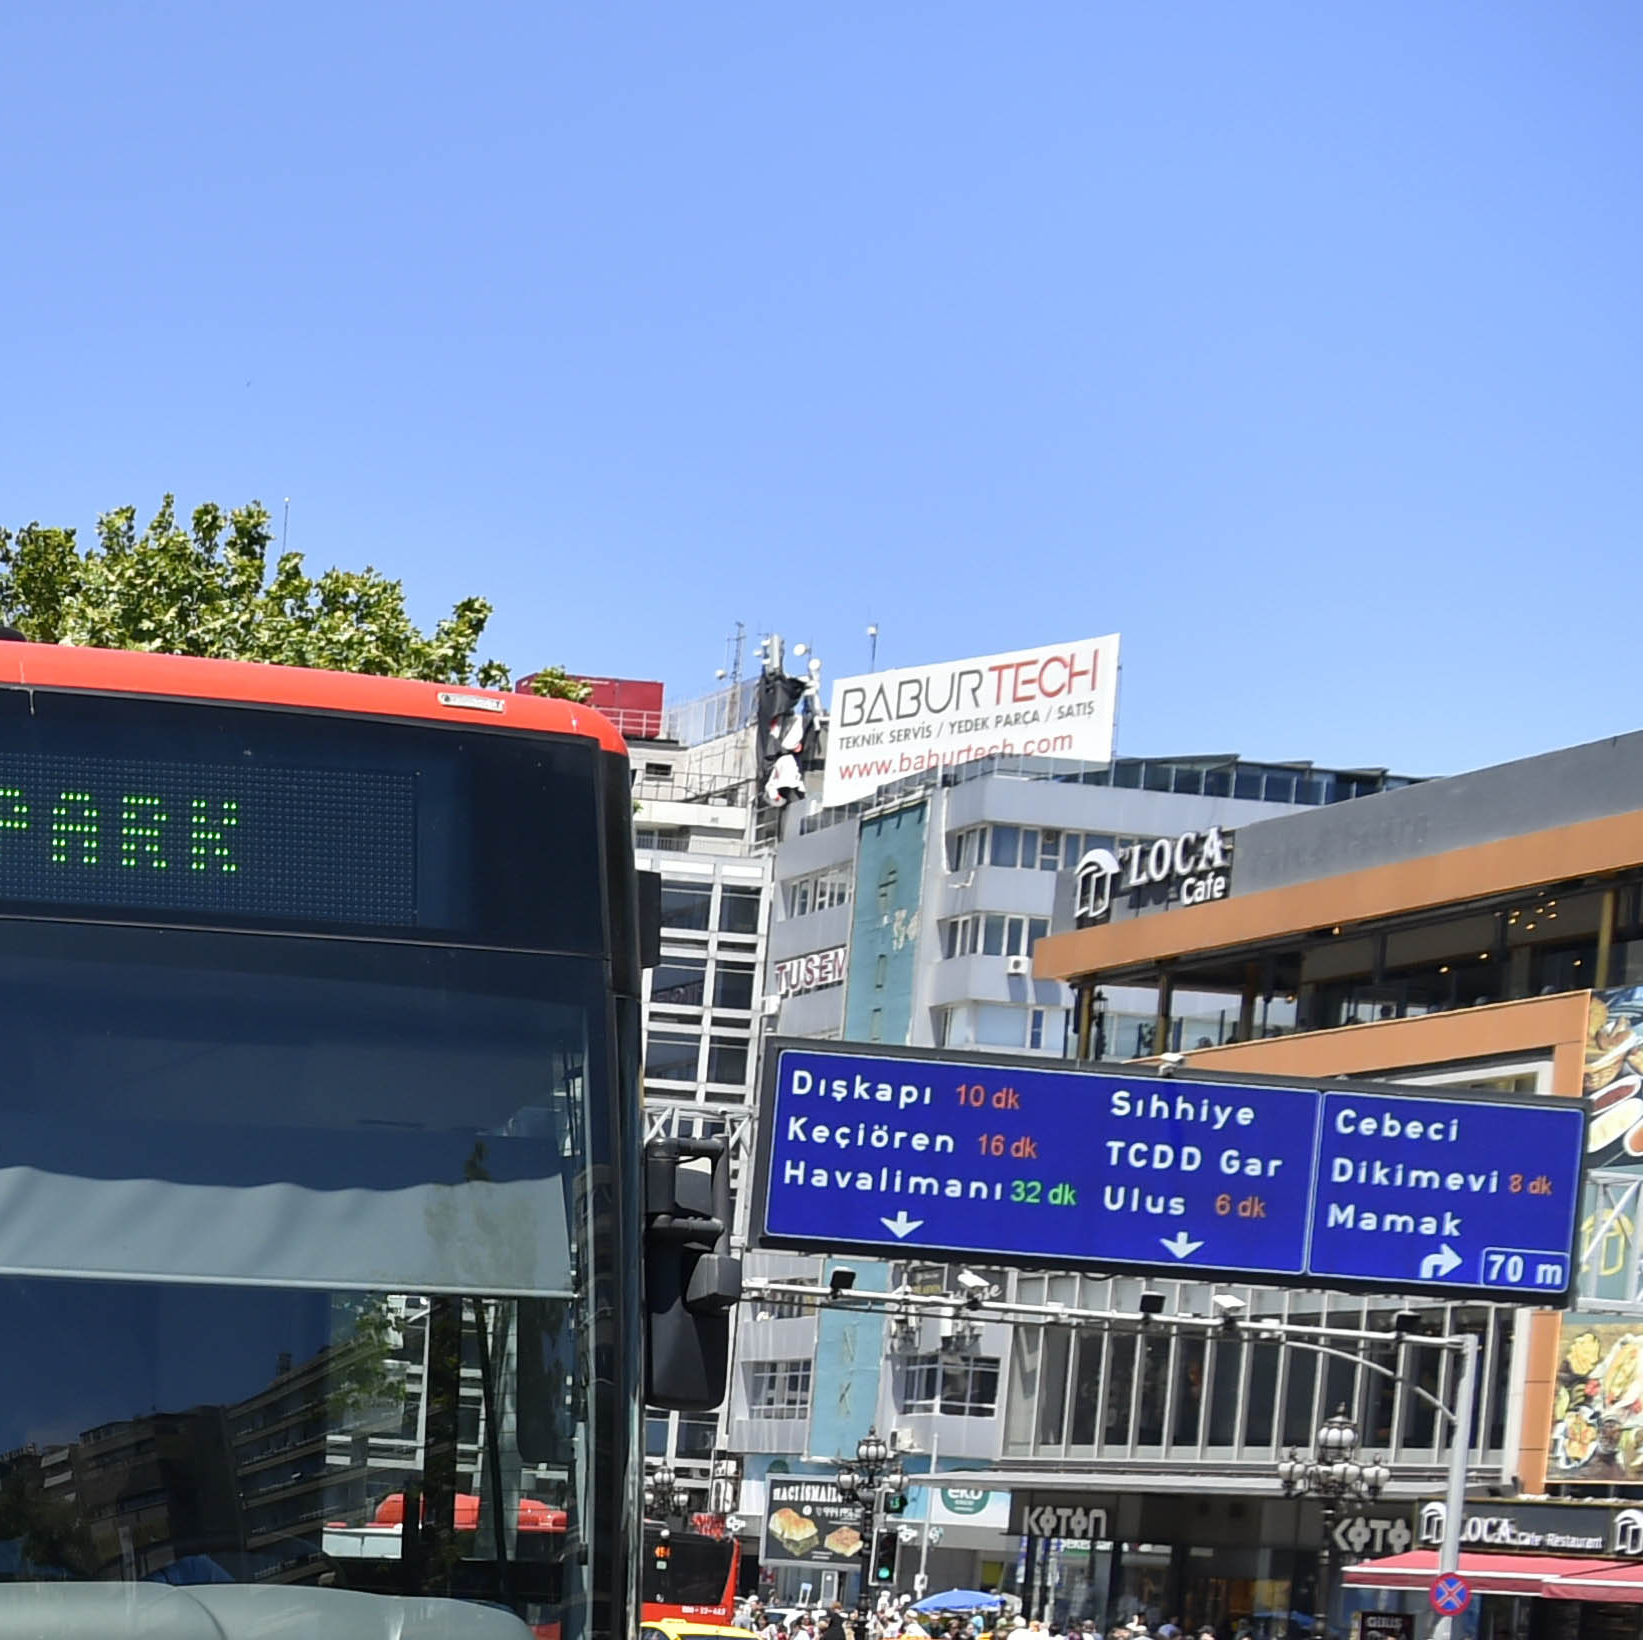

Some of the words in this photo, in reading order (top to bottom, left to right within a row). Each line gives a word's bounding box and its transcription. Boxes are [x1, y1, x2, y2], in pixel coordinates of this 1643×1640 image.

[838, 727, 884, 750] TEKNİK
[889, 720, 932, 743] SERVİS
[949, 715, 989, 736] YEDEK
[994, 708, 1041, 728] PARÇA
[1057, 700, 1095, 720] SATIŞ
[838, 733, 1073, 781] www.baburtech.com
[1127, 825, 1229, 888] LOCA
[1179, 873, 1227, 906] Cafe
[792, 1070, 932, 1110] Dışkapı
[956, 1084, 985, 1108] 10
[992, 1088, 1020, 1110] dk
[1110, 1090, 1255, 1130] Sıhhiye
[1335, 1108, 1460, 1142] Cebeci
[787, 1116, 955, 1154] Keçiören
[978, 1135, 1004, 1157] 16
[1010, 1136, 1038, 1158] dk
[1106, 1140, 1202, 1171] TCDD
[1219, 1149, 1283, 1177] Gar
[1331, 1157, 1499, 1194] Dikimevi
[1508, 1173, 1523, 1194] 8
[1527, 1175, 1553, 1196] dk
[784, 1160, 1002, 1201] Havalimanı
[1010, 1181, 1042, 1203] 32
[1048, 1184, 1077, 1206] dk
[1104, 1185, 1186, 1216] Ulus
[1215, 1193, 1231, 1216] 6
[1237, 1195, 1267, 1218] dk
[1327, 1203, 1462, 1237] Mamak
[1487, 1254, 1524, 1283] 70
[1536, 1263, 1563, 1285] m
